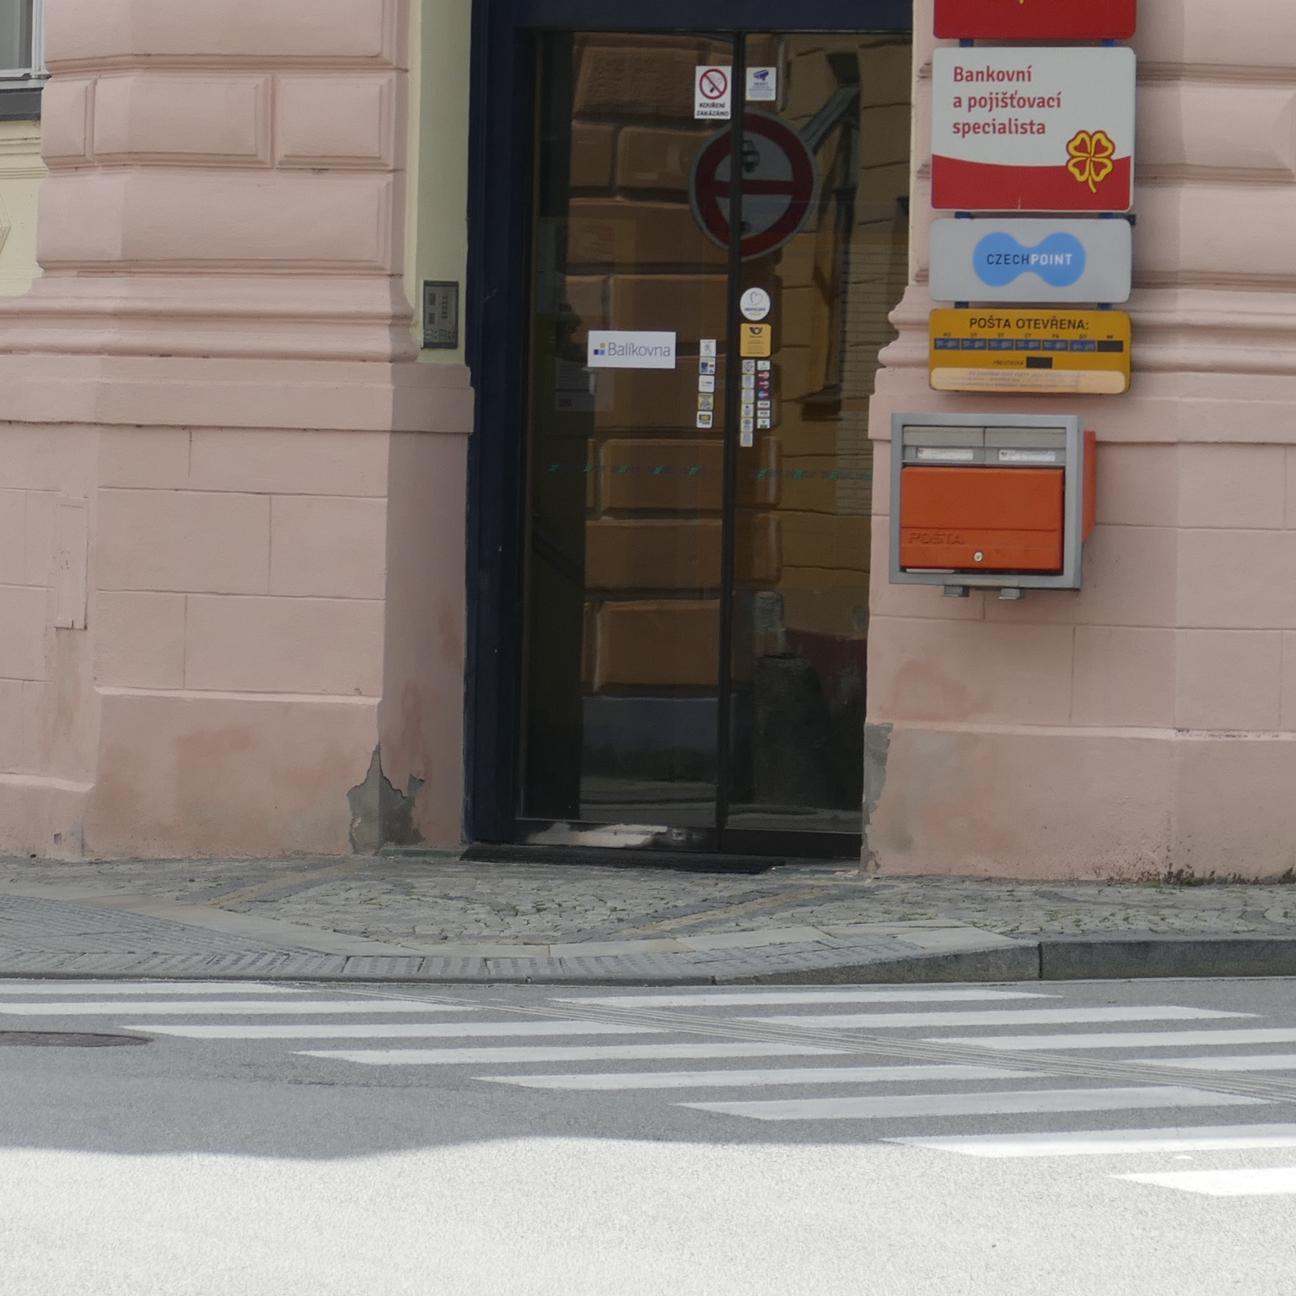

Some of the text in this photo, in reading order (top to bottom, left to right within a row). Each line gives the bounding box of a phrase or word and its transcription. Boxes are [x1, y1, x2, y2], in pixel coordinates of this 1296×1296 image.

[952, 65, 1032, 83] Bankovní
[952, 90, 1062, 113] a pojišťovací
[952, 119, 1046, 138] specialista
[969, 315, 1089, 330] POŠTA OTEVŘENA:
[607, 341, 671, 357] Balíkovna
